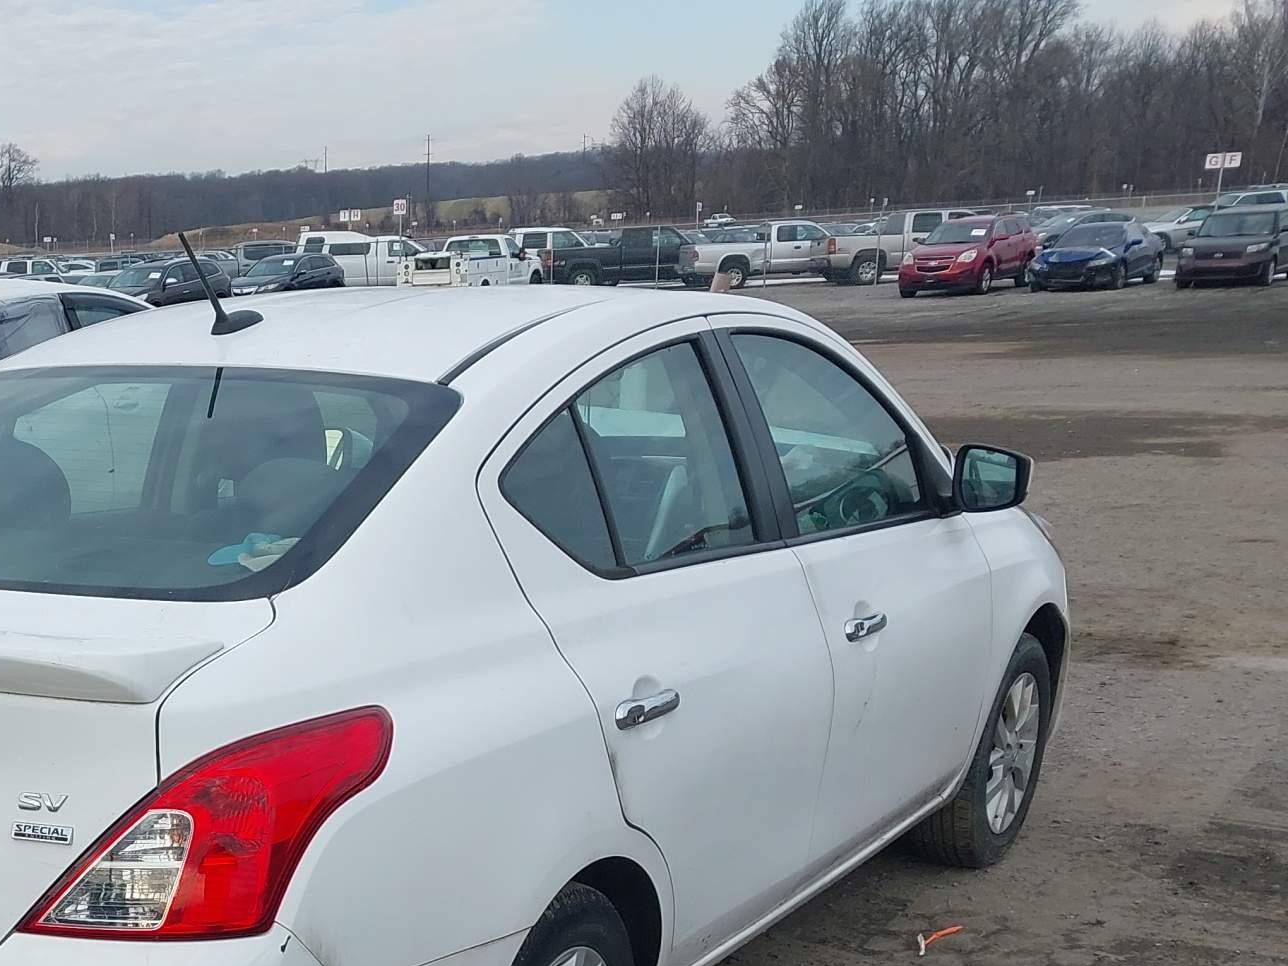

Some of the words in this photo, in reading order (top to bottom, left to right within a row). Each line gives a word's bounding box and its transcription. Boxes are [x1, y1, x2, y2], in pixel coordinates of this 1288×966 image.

[1209, 157, 1217, 166] G
[1229, 156, 1237, 165] F
[394, 202, 405, 211] 30
[18, 792, 69, 812] SV
[14, 824, 69, 837] SPECIAL
